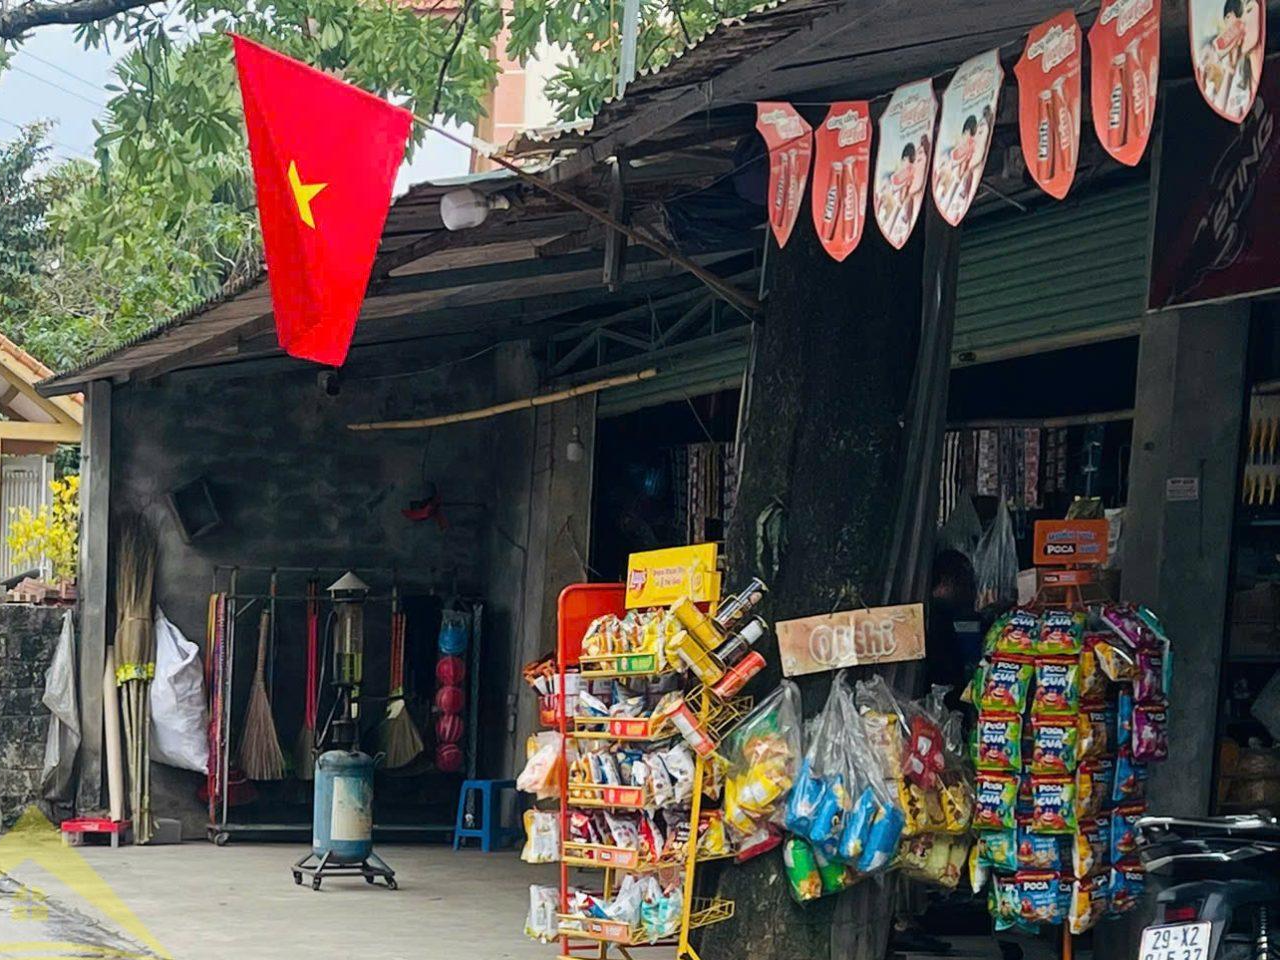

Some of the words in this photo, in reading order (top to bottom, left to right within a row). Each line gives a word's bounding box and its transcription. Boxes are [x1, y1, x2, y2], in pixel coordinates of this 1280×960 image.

[1046, 544, 1074, 554] POCA
[1024, 882, 1048, 890] POCA
[1151, 926, 1199, 951] 29-X2
